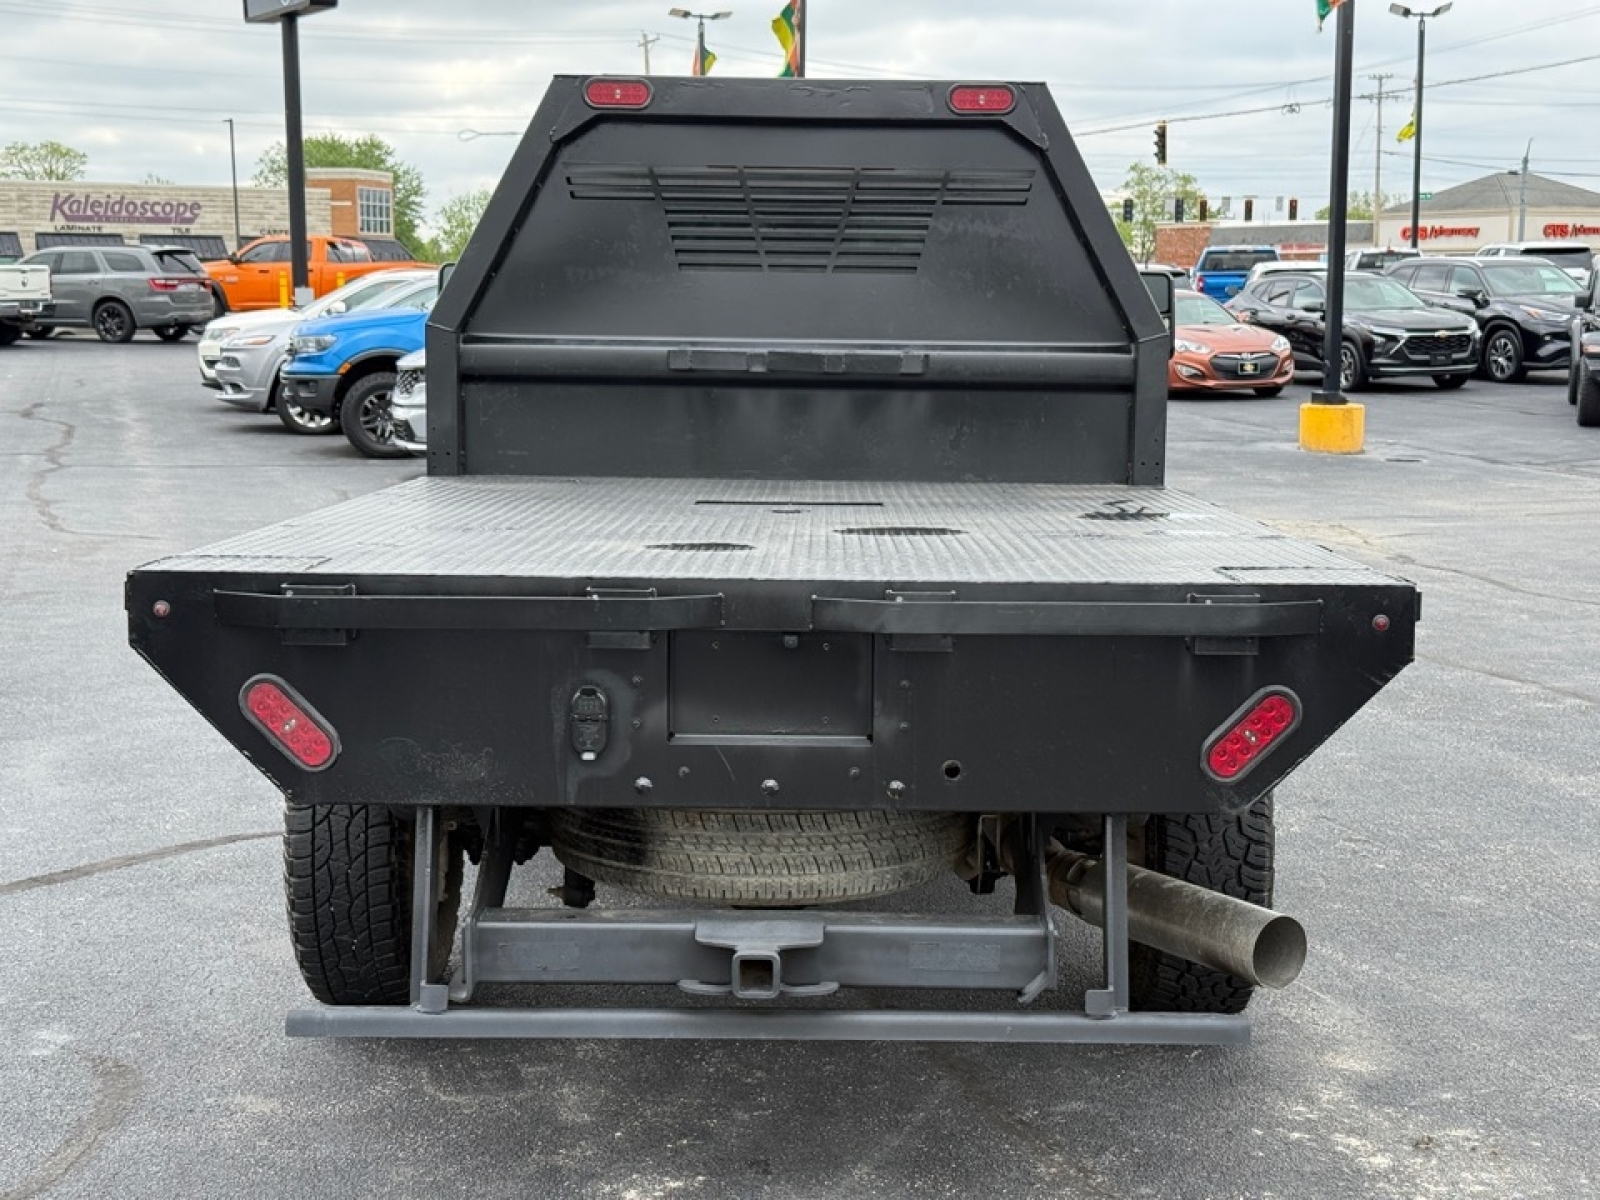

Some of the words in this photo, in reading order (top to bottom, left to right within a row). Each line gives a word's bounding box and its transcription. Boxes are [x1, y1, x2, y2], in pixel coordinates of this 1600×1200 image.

[50, 192, 202, 225] Kaleidoscope
[54, 225, 103, 233] LAMINATE
[172, 227, 191, 235] TILE
[1401, 226, 1428, 241] CS
